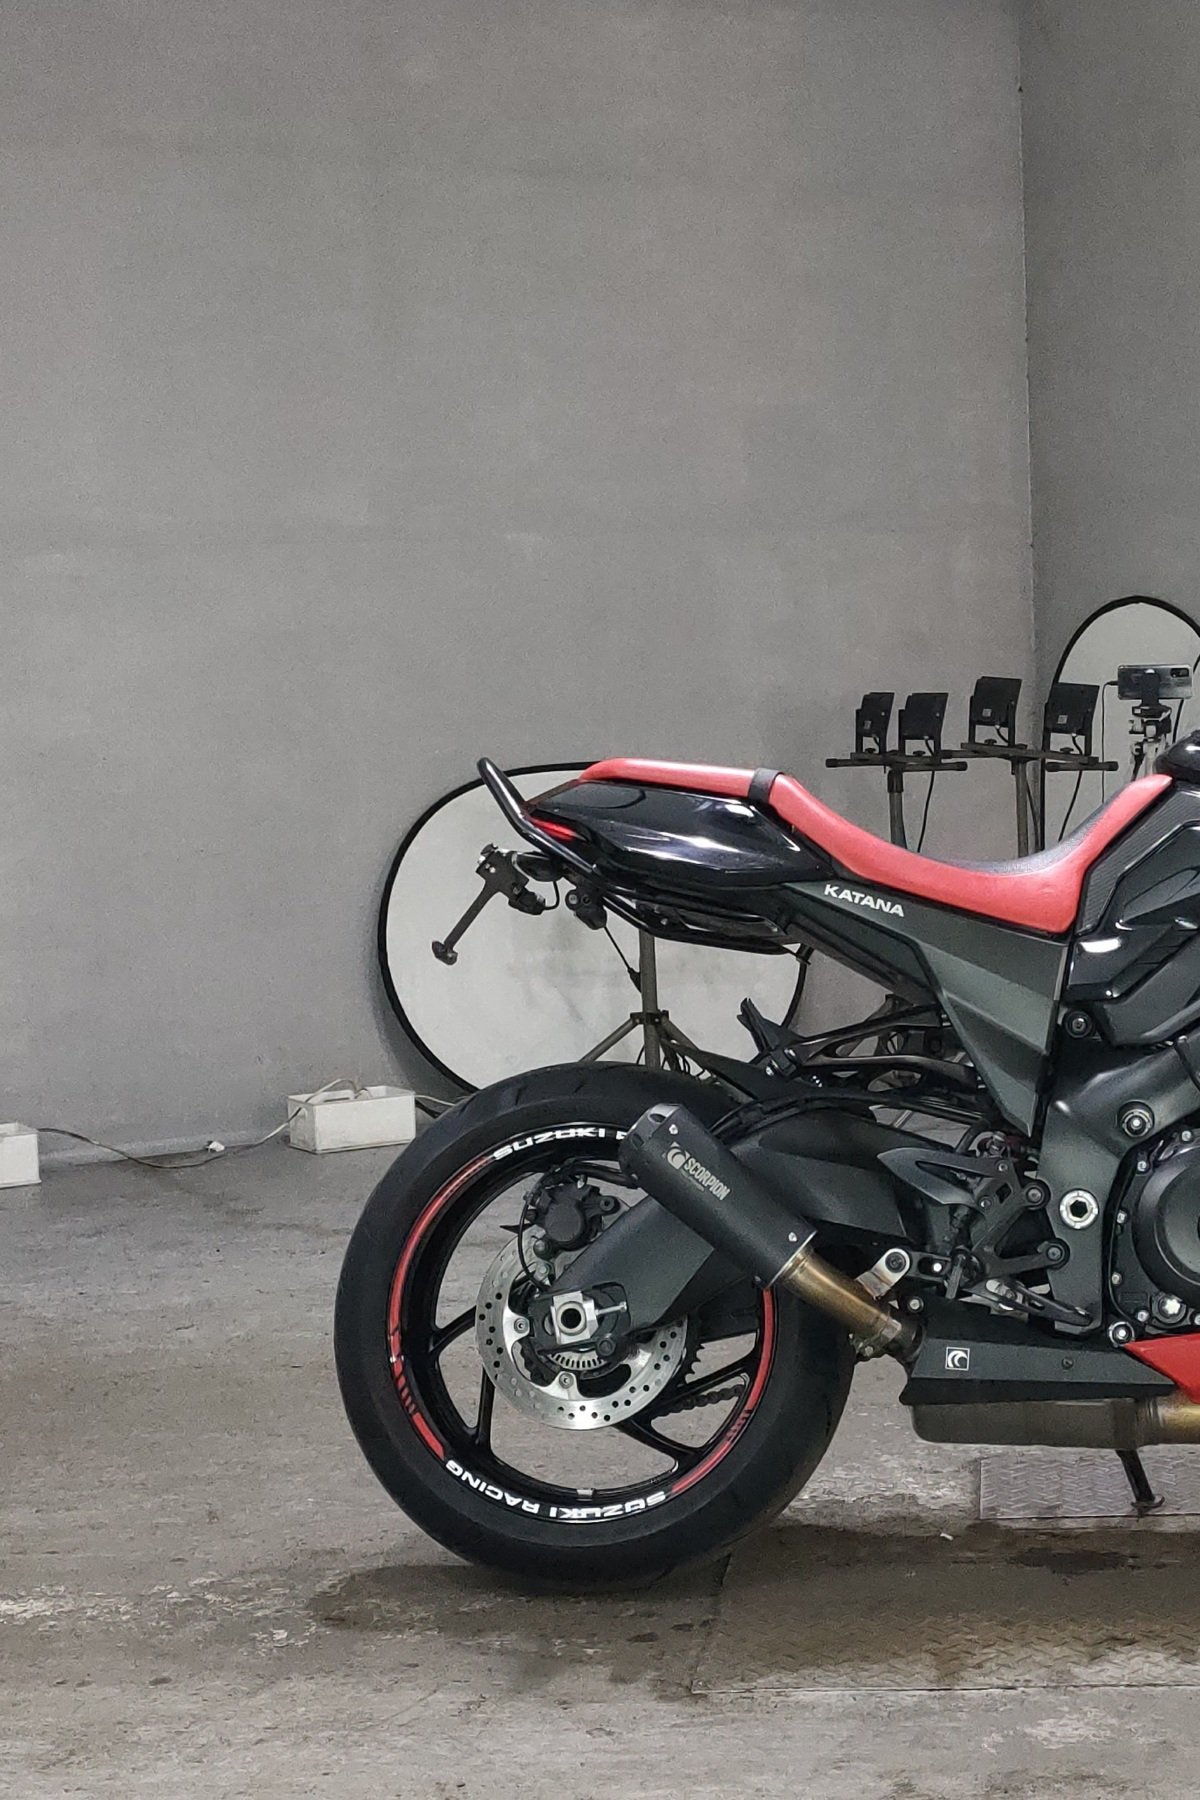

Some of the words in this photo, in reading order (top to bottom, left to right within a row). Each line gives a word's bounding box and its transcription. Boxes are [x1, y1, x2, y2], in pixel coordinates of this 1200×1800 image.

[824, 884, 904, 917] KATANA
[492, 1127, 606, 1160] SUZUKI
[683, 1157, 731, 1201] SCORPION
[445, 1459, 541, 1514] RACING
[549, 1490, 667, 1519] SUZUKI
